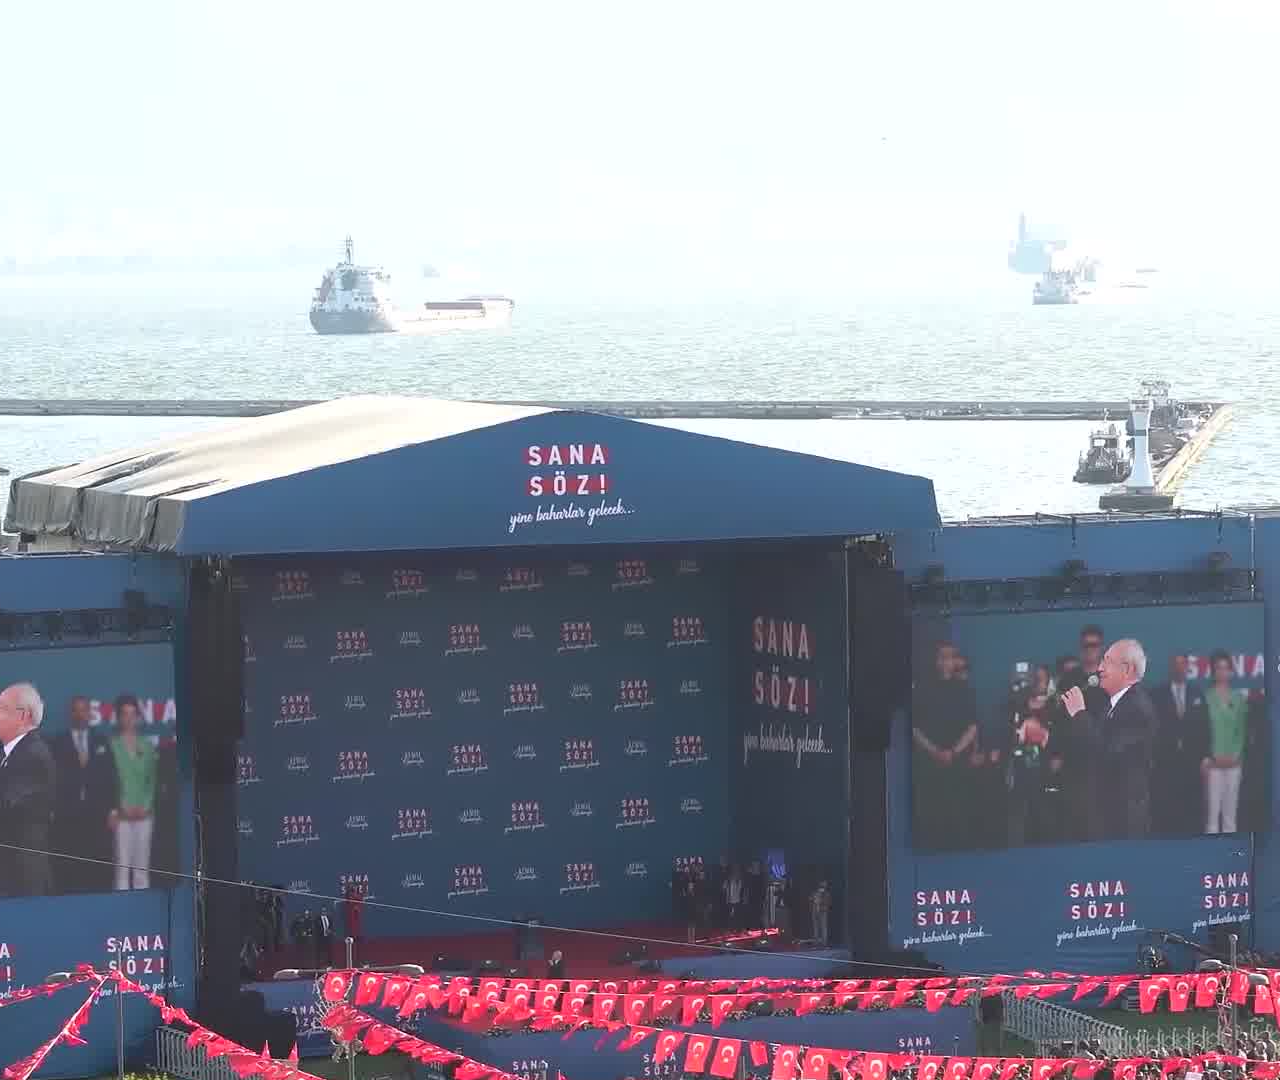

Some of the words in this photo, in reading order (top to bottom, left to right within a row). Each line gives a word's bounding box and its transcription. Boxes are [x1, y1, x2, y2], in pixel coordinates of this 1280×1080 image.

[528, 444, 606, 466] SANA
[529, 471, 606, 497] SÖZ!
[508, 513, 534, 533] yine
[536, 502, 586, 522] baharlar
[587, 498, 636, 526] gelecek...
[753, 616, 810, 660] SANA
[754, 664, 809, 715] SÖZ!
[1204, 872, 1248, 888] SANA
[916, 889, 971, 906] SANA
[1070, 881, 1124, 898] SANA
[1204, 891, 1248, 908] SÖZ!
[917, 908, 971, 927] SÖZ!
[1071, 901, 1125, 920] SÖZ!
[1075, 923, 1111, 938] baharlar
[106, 935, 164, 953] SANA
[898, 1036, 932, 1048] SANA
